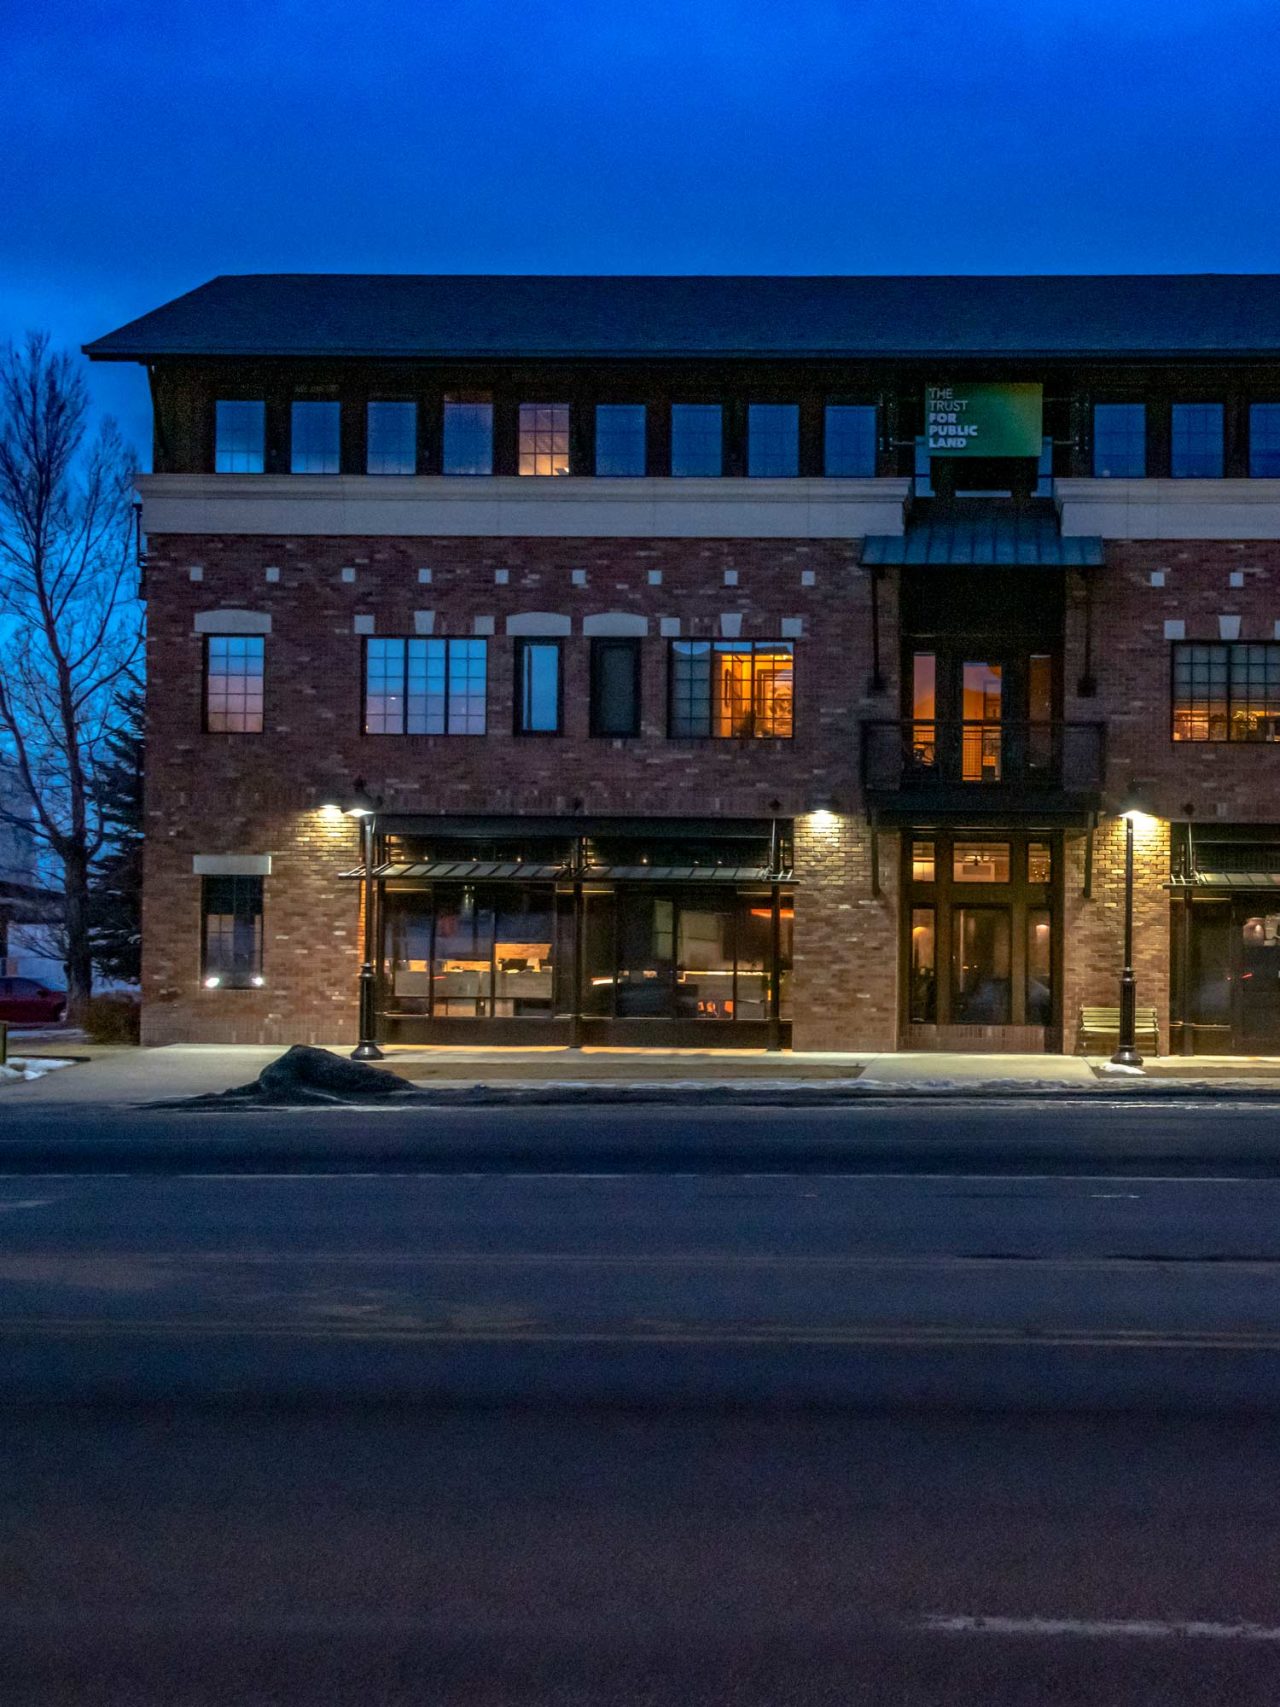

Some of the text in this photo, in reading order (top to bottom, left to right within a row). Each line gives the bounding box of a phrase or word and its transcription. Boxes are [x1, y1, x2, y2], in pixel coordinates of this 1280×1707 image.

[928, 387, 954, 399] THE
[928, 400, 969, 412] TRUST
[928, 413, 957, 424] FOR
[928, 425, 978, 436] PUBLIC
[928, 437, 967, 448] LAND
